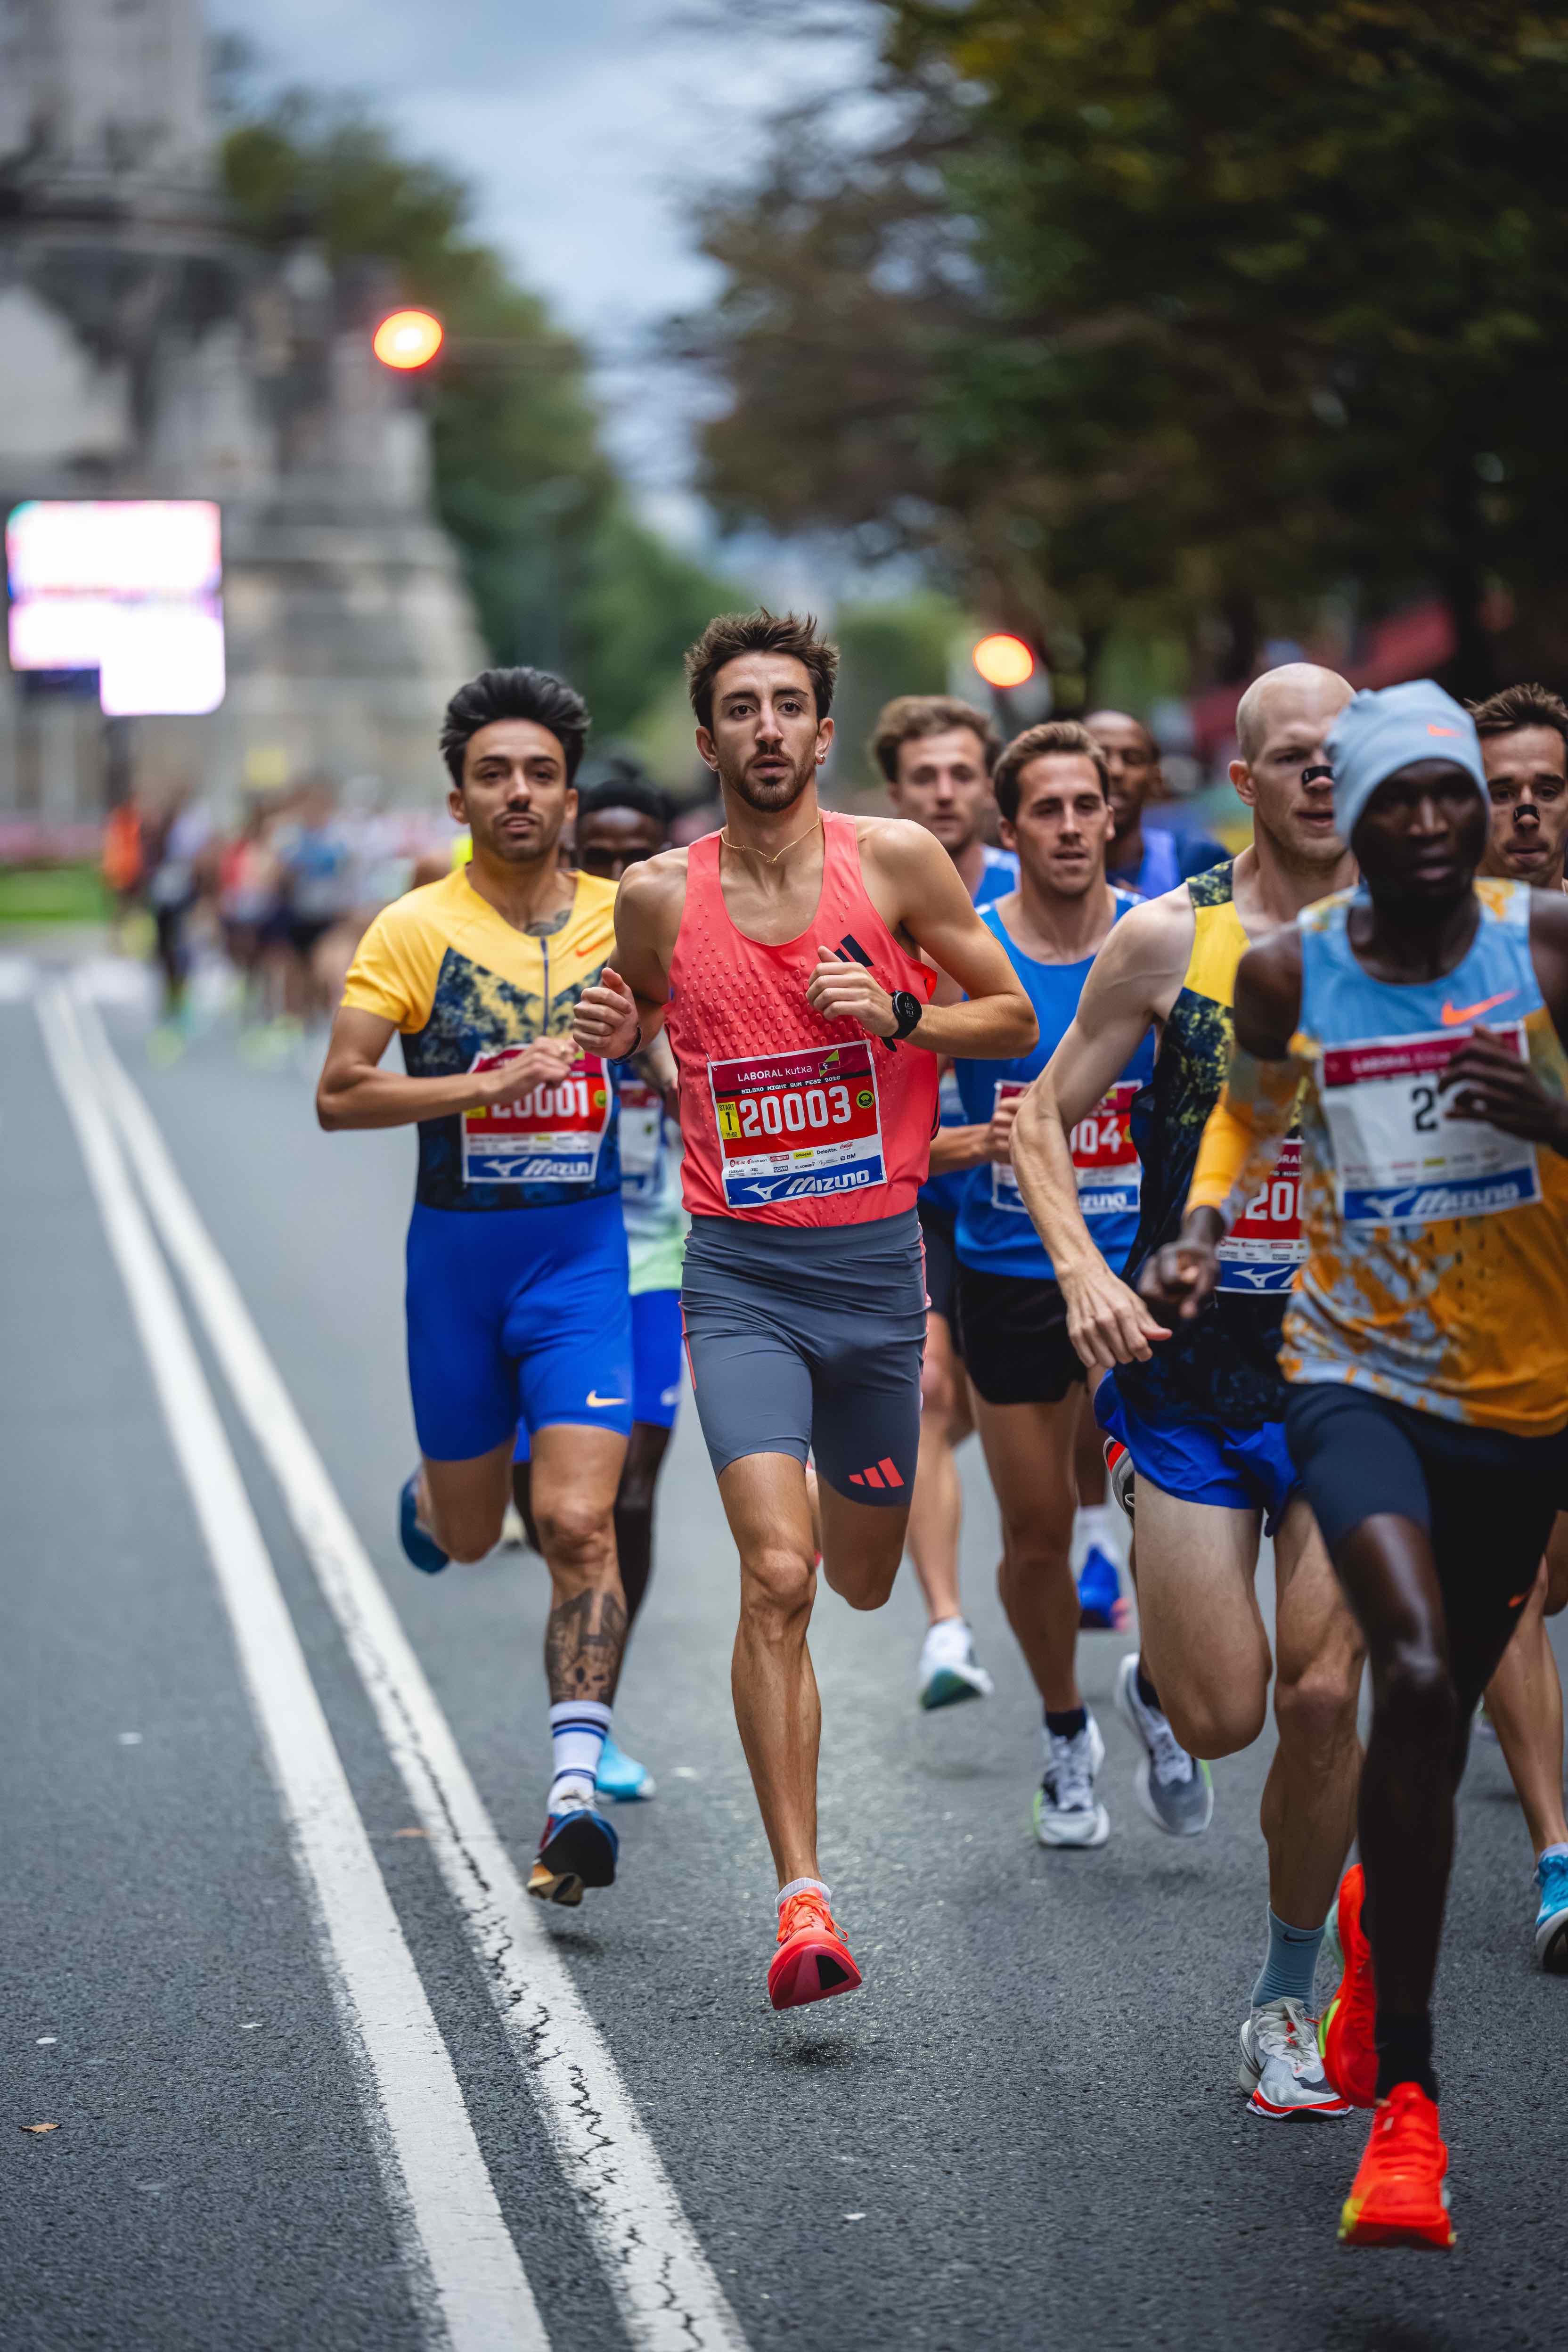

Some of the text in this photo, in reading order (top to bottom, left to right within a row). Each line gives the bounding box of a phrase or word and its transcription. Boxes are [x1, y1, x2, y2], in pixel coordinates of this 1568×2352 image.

[737, 1065, 812, 1082] LABORAL kutxa
[725, 1112, 732, 1130] 1
[739, 1086, 851, 1137] 20003
[1245, 1181, 1304, 1221] 20
